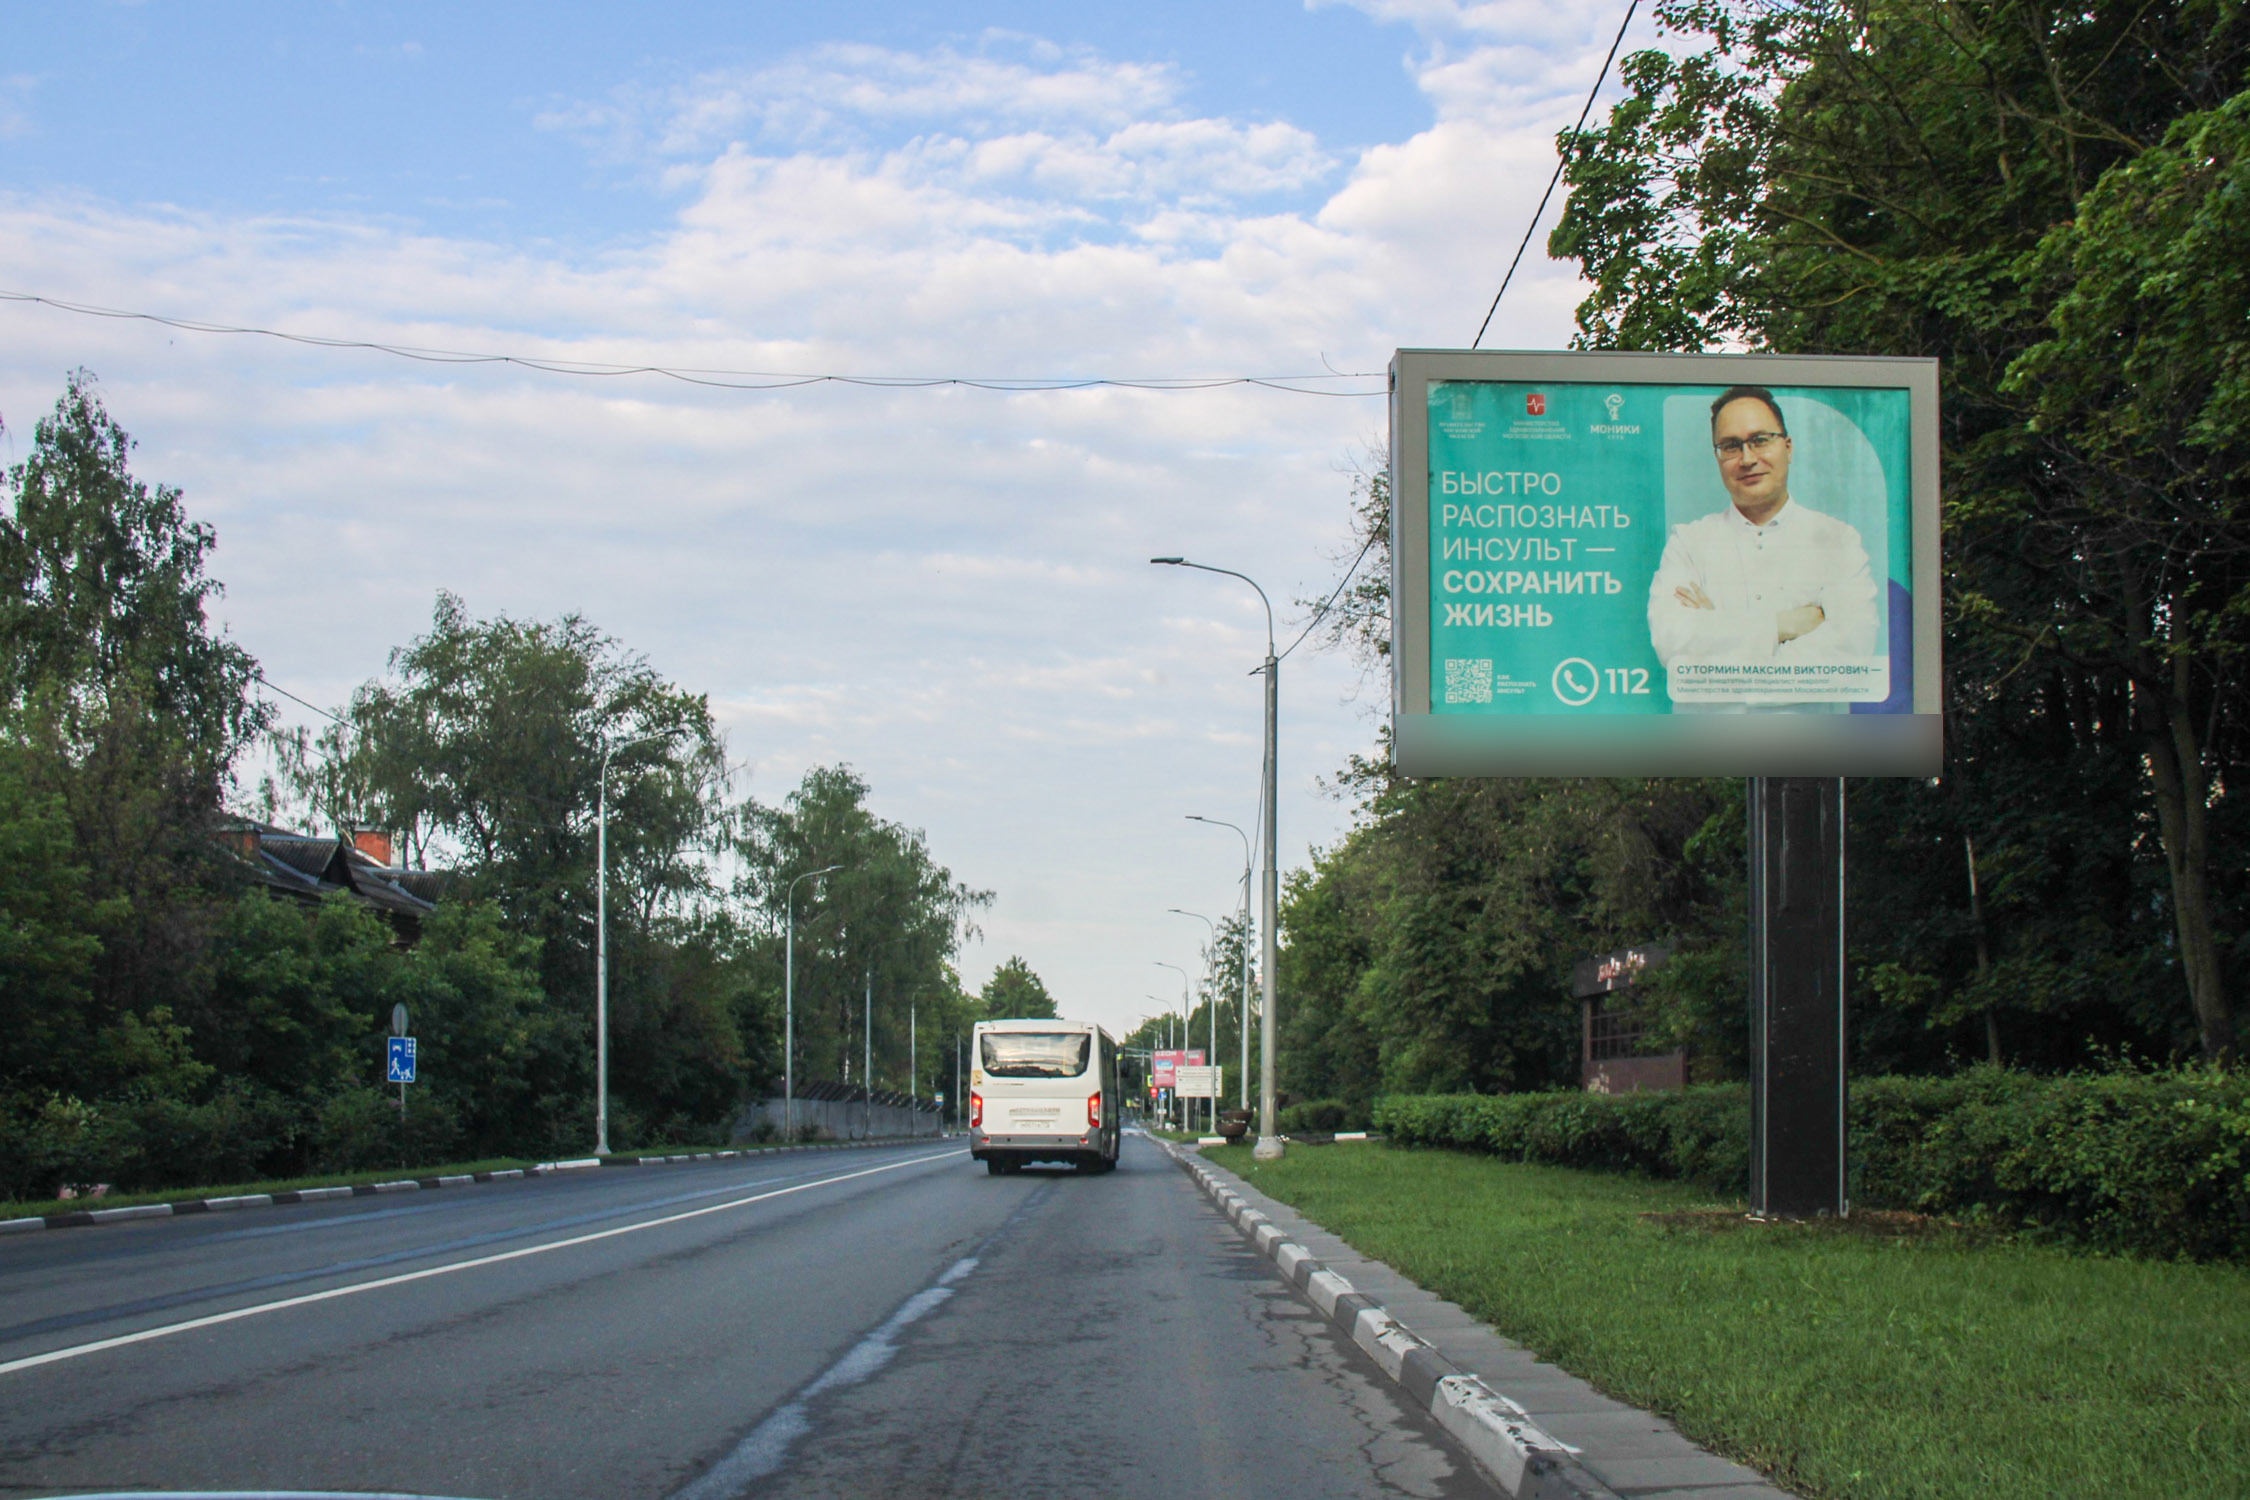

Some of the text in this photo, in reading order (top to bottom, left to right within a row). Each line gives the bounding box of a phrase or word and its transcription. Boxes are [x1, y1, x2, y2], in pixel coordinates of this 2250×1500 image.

[1590, 424, 1640, 435] МОНИКИ
[1442, 471, 1561, 495] БЫСТРО
[1443, 504, 1631, 528] РАСПОЗНАТЬ
[1443, 537, 1578, 561] ИНСУЛЬТ
[1443, 570, 1622, 594] СОХРАНИТЬ
[1443, 603, 1553, 627] ЖИЗНЬ
[1604, 668, 1650, 694] 112
[1677, 665, 1740, 675] СУТОРМИН
[1742, 665, 1792, 675] МАКСИМ
[1794, 665, 1869, 675] ВИКТОРОВИЧ
